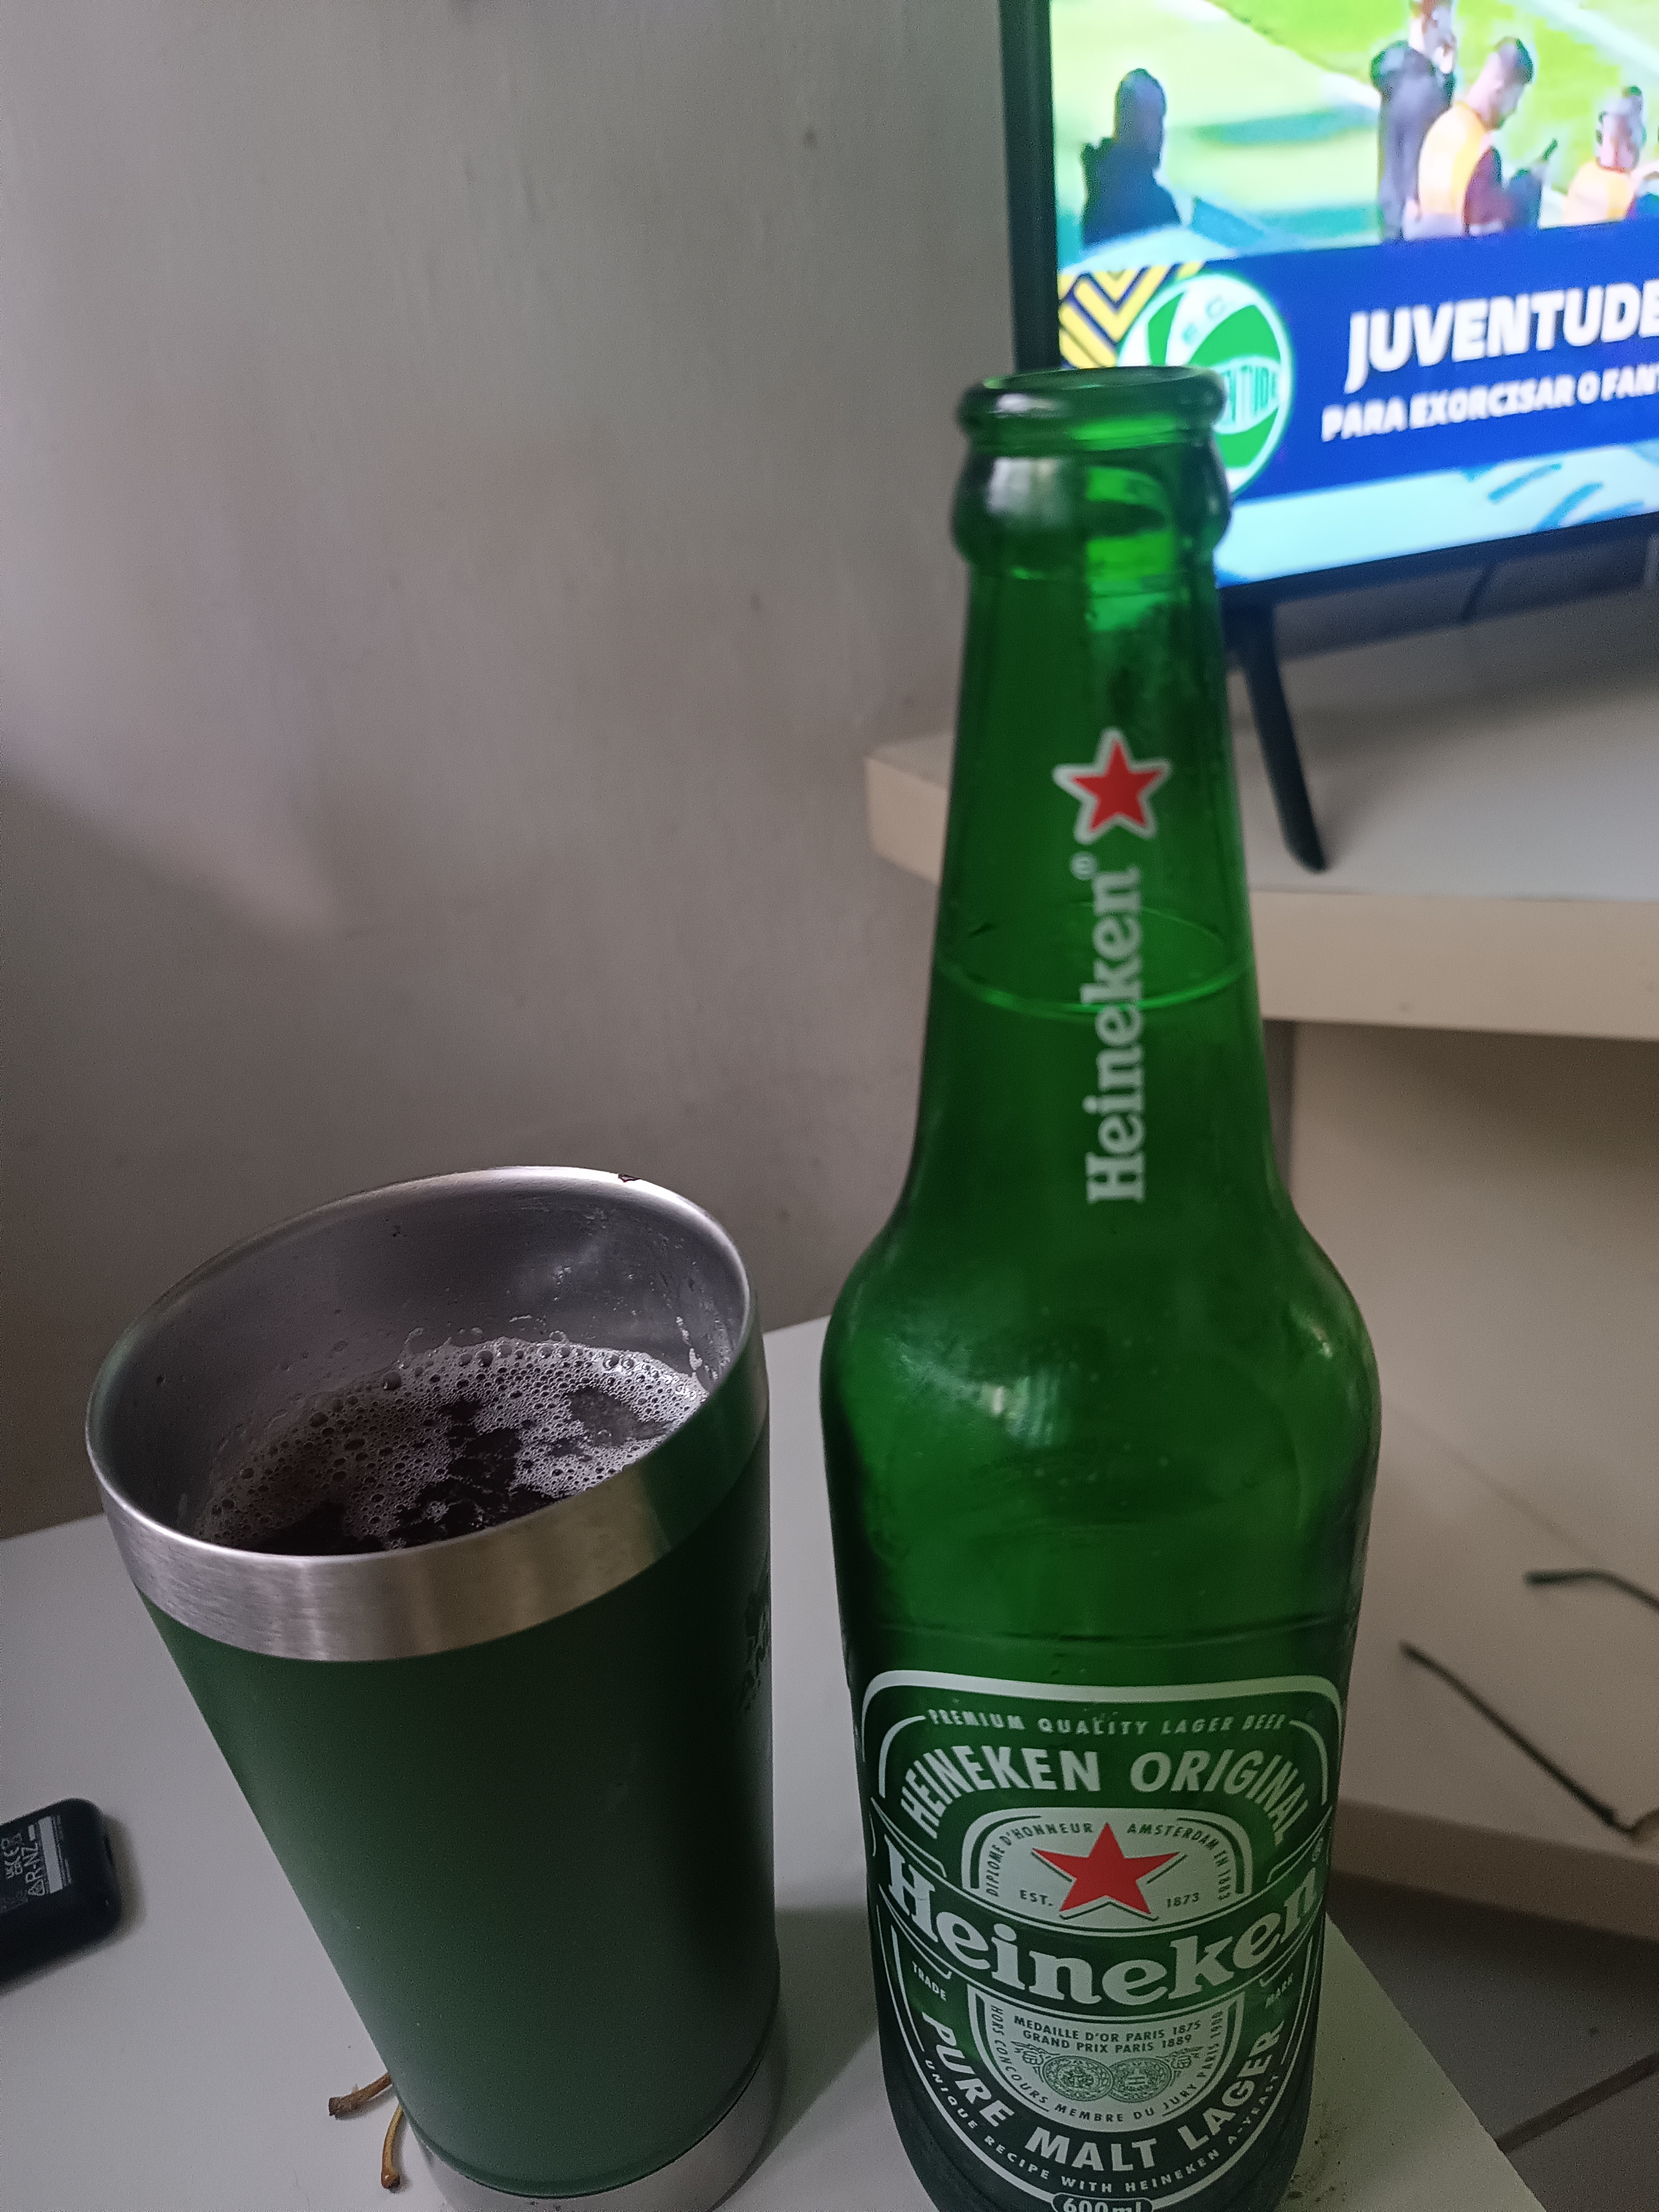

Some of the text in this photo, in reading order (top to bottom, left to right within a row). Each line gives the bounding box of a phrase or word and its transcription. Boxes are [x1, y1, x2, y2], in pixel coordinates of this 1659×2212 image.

[1344, 278, 1659, 394] JUVENTUDE
[1321, 397, 1408, 442] PARA
[1577, 371, 1601, 404] O
[1079, 865, 1145, 1203] Heineken
[927, 1709, 1286, 1736] PREMIUM QUALITY LAGER BEER
[900, 1745, 1308, 1846] HEINEKEN ORIGINAL
[1126, 1823, 1220, 1850] AMSTERDAM
[985, 1823, 1093, 1897] DIPLOME D'HONNEUR
[1019, 1889, 1053, 1906] EST.
[1166, 1892, 1199, 1908] 1873
[884, 1834, 1318, 2005] Heineken
[911, 1960, 947, 2002] TRADE
[990, 2005, 1005, 2036] HORS
[1014, 2015, 1201, 2042] MEDAILLE D'OR PARIS 1875
[1023, 2030, 1192, 2053] GRAND PRIX PARIS 1889
[994, 2039, 1048, 2103] CONCOURS
[921, 2011, 1285, 2171] PURE MALT LAGER
[1162, 2083, 1197, 2110] JURY
[925, 2059, 978, 2129] UNIQUE
[984, 2135, 1050, 2179] RECIPE
[1061, 2176, 1112, 2193] WITH
[1125, 2149, 1219, 2193] HEINEKEN
[1054, 2104, 1124, 2122] MEMBRE
[1133, 2107, 1155, 2120] DU
